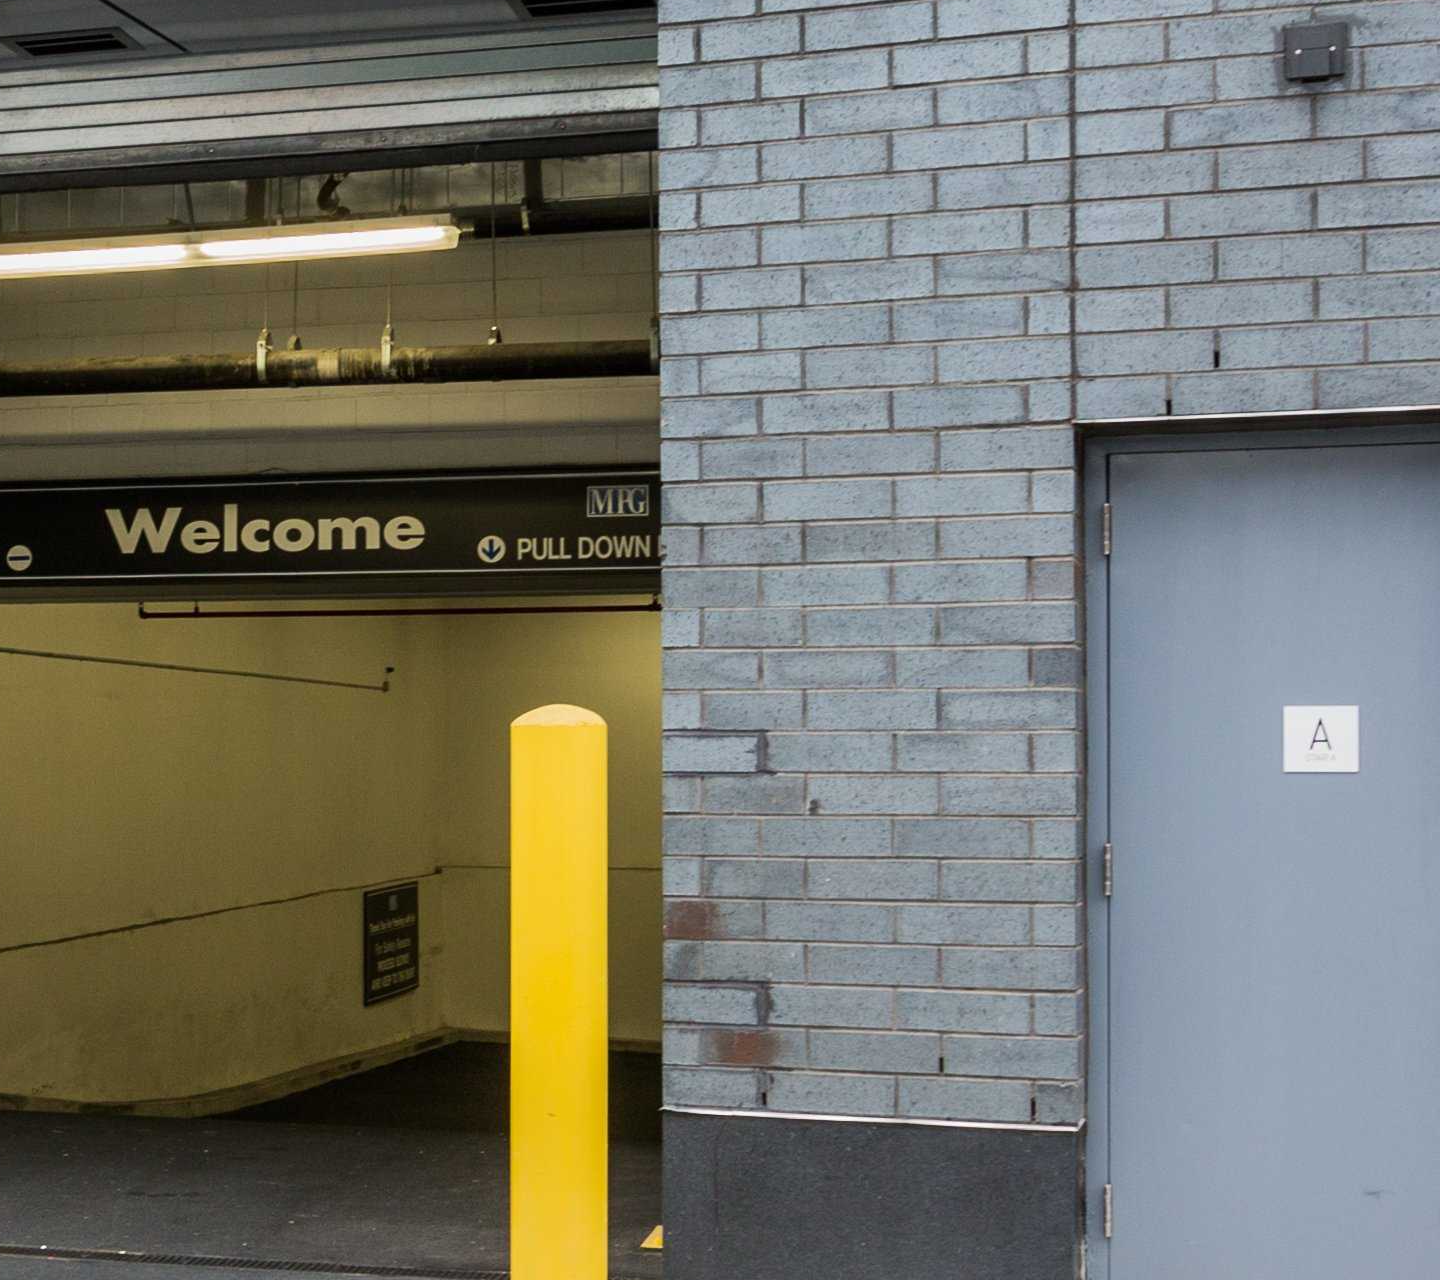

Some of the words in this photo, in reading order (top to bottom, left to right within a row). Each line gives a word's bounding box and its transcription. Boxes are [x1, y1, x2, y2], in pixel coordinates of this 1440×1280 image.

[590, 487, 647, 515] MPG
[106, 503, 426, 554] Welcome
[517, 537, 572, 560] PULL
[577, 535, 651, 559] DOWN
[1310, 717, 1331, 750] A
